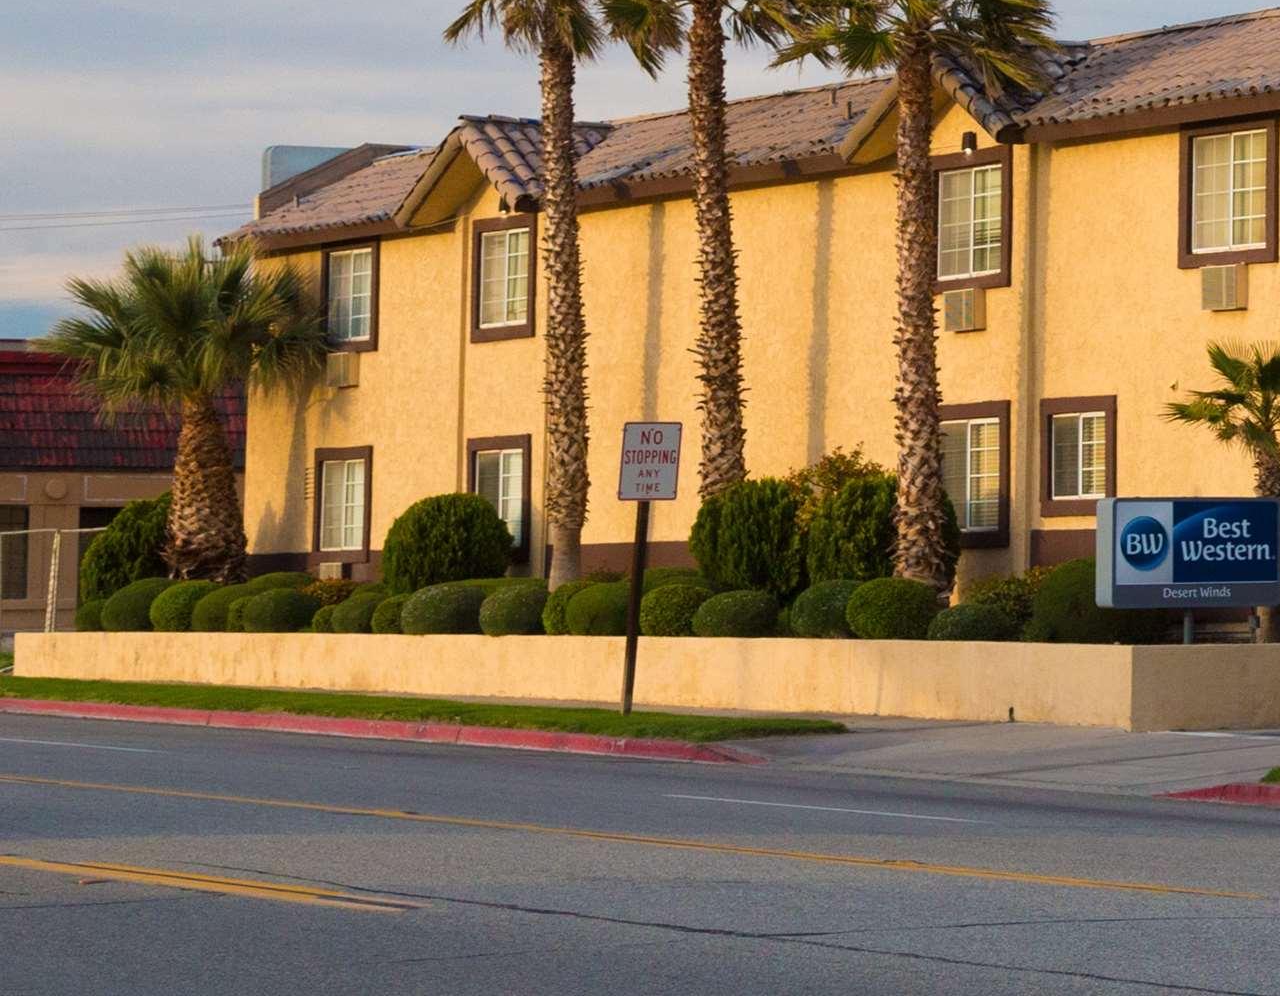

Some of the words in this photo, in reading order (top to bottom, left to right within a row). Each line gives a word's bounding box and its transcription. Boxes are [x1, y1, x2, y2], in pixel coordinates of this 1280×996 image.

[640, 430, 664, 445] NO
[624, 450, 677, 465] STOPPING
[638, 469, 661, 478] ANY
[635, 483, 661, 493] TIME
[1203, 517, 1251, 539] Best
[1126, 533, 1164, 555] BW
[1181, 540, 1270, 562] Western
[1162, 587, 1198, 599] Desert
[1200, 586, 1232, 598] Winds
